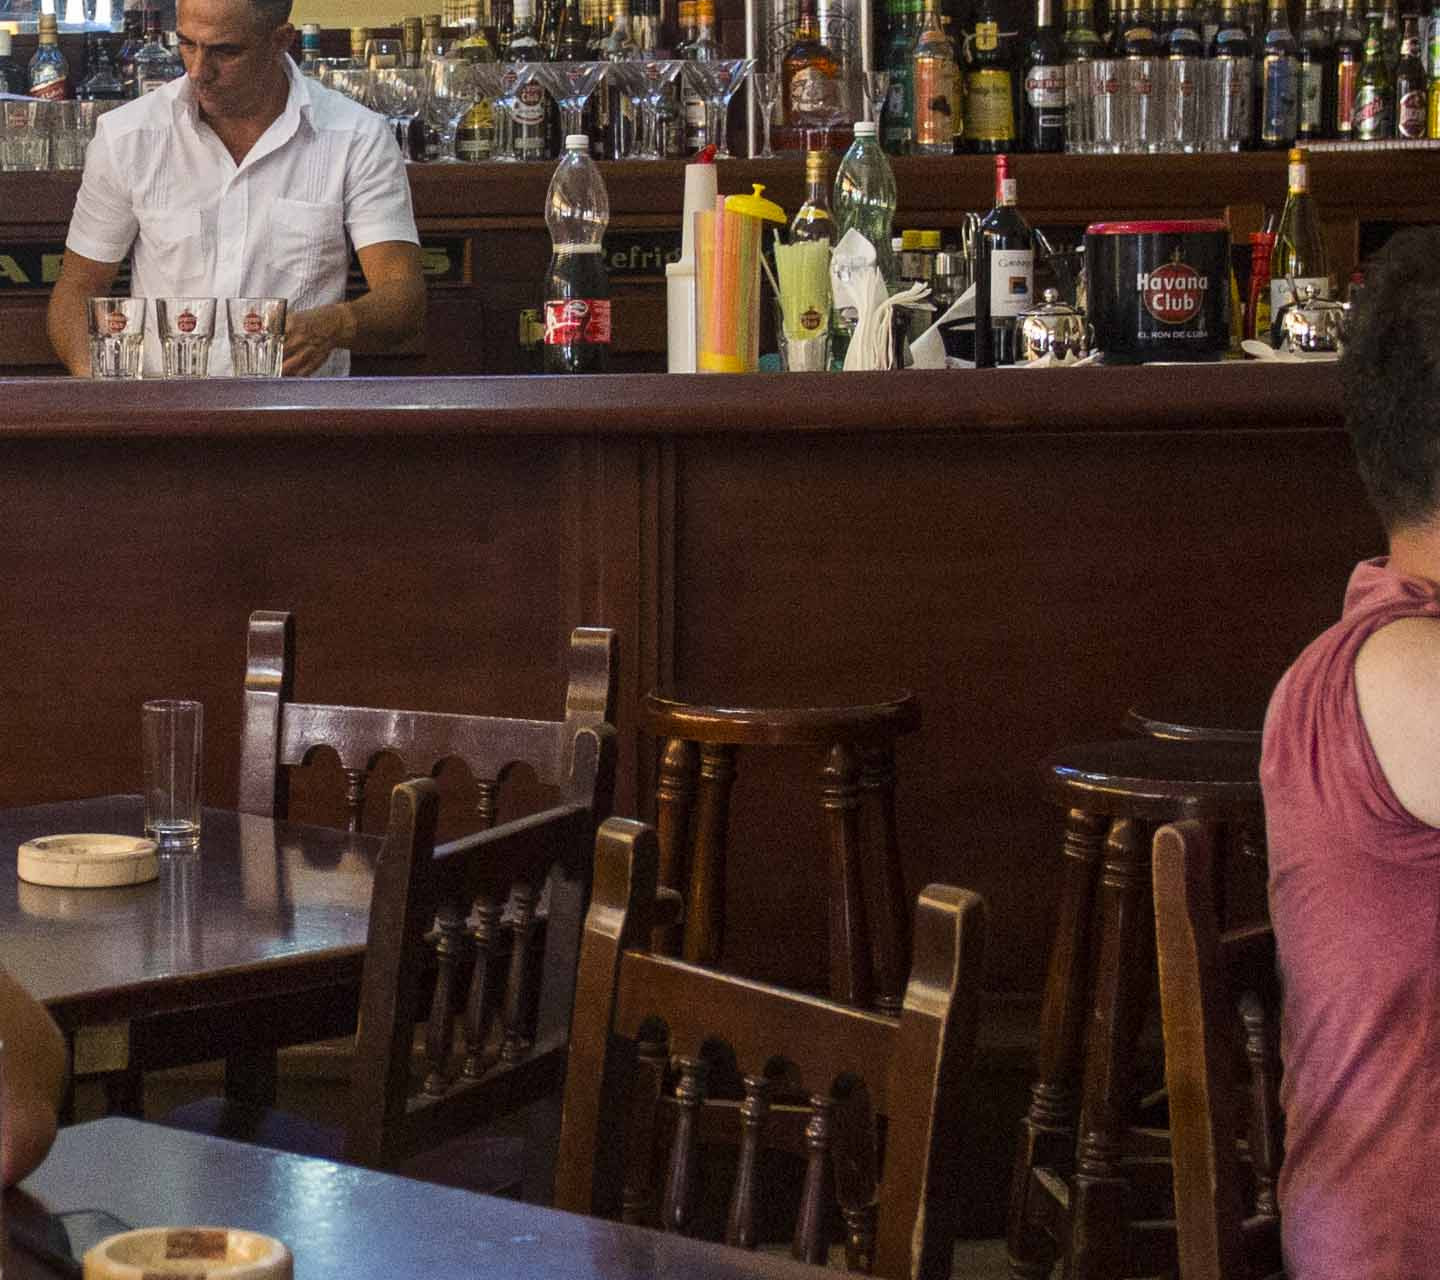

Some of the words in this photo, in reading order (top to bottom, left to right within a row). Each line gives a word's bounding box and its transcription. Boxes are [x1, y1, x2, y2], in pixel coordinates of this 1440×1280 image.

[1136, 273, 1209, 291] Havana
[1152, 293, 1195, 311] Club
[1137, 331, 1149, 339] EL
[1151, 331, 1171, 339] RON
